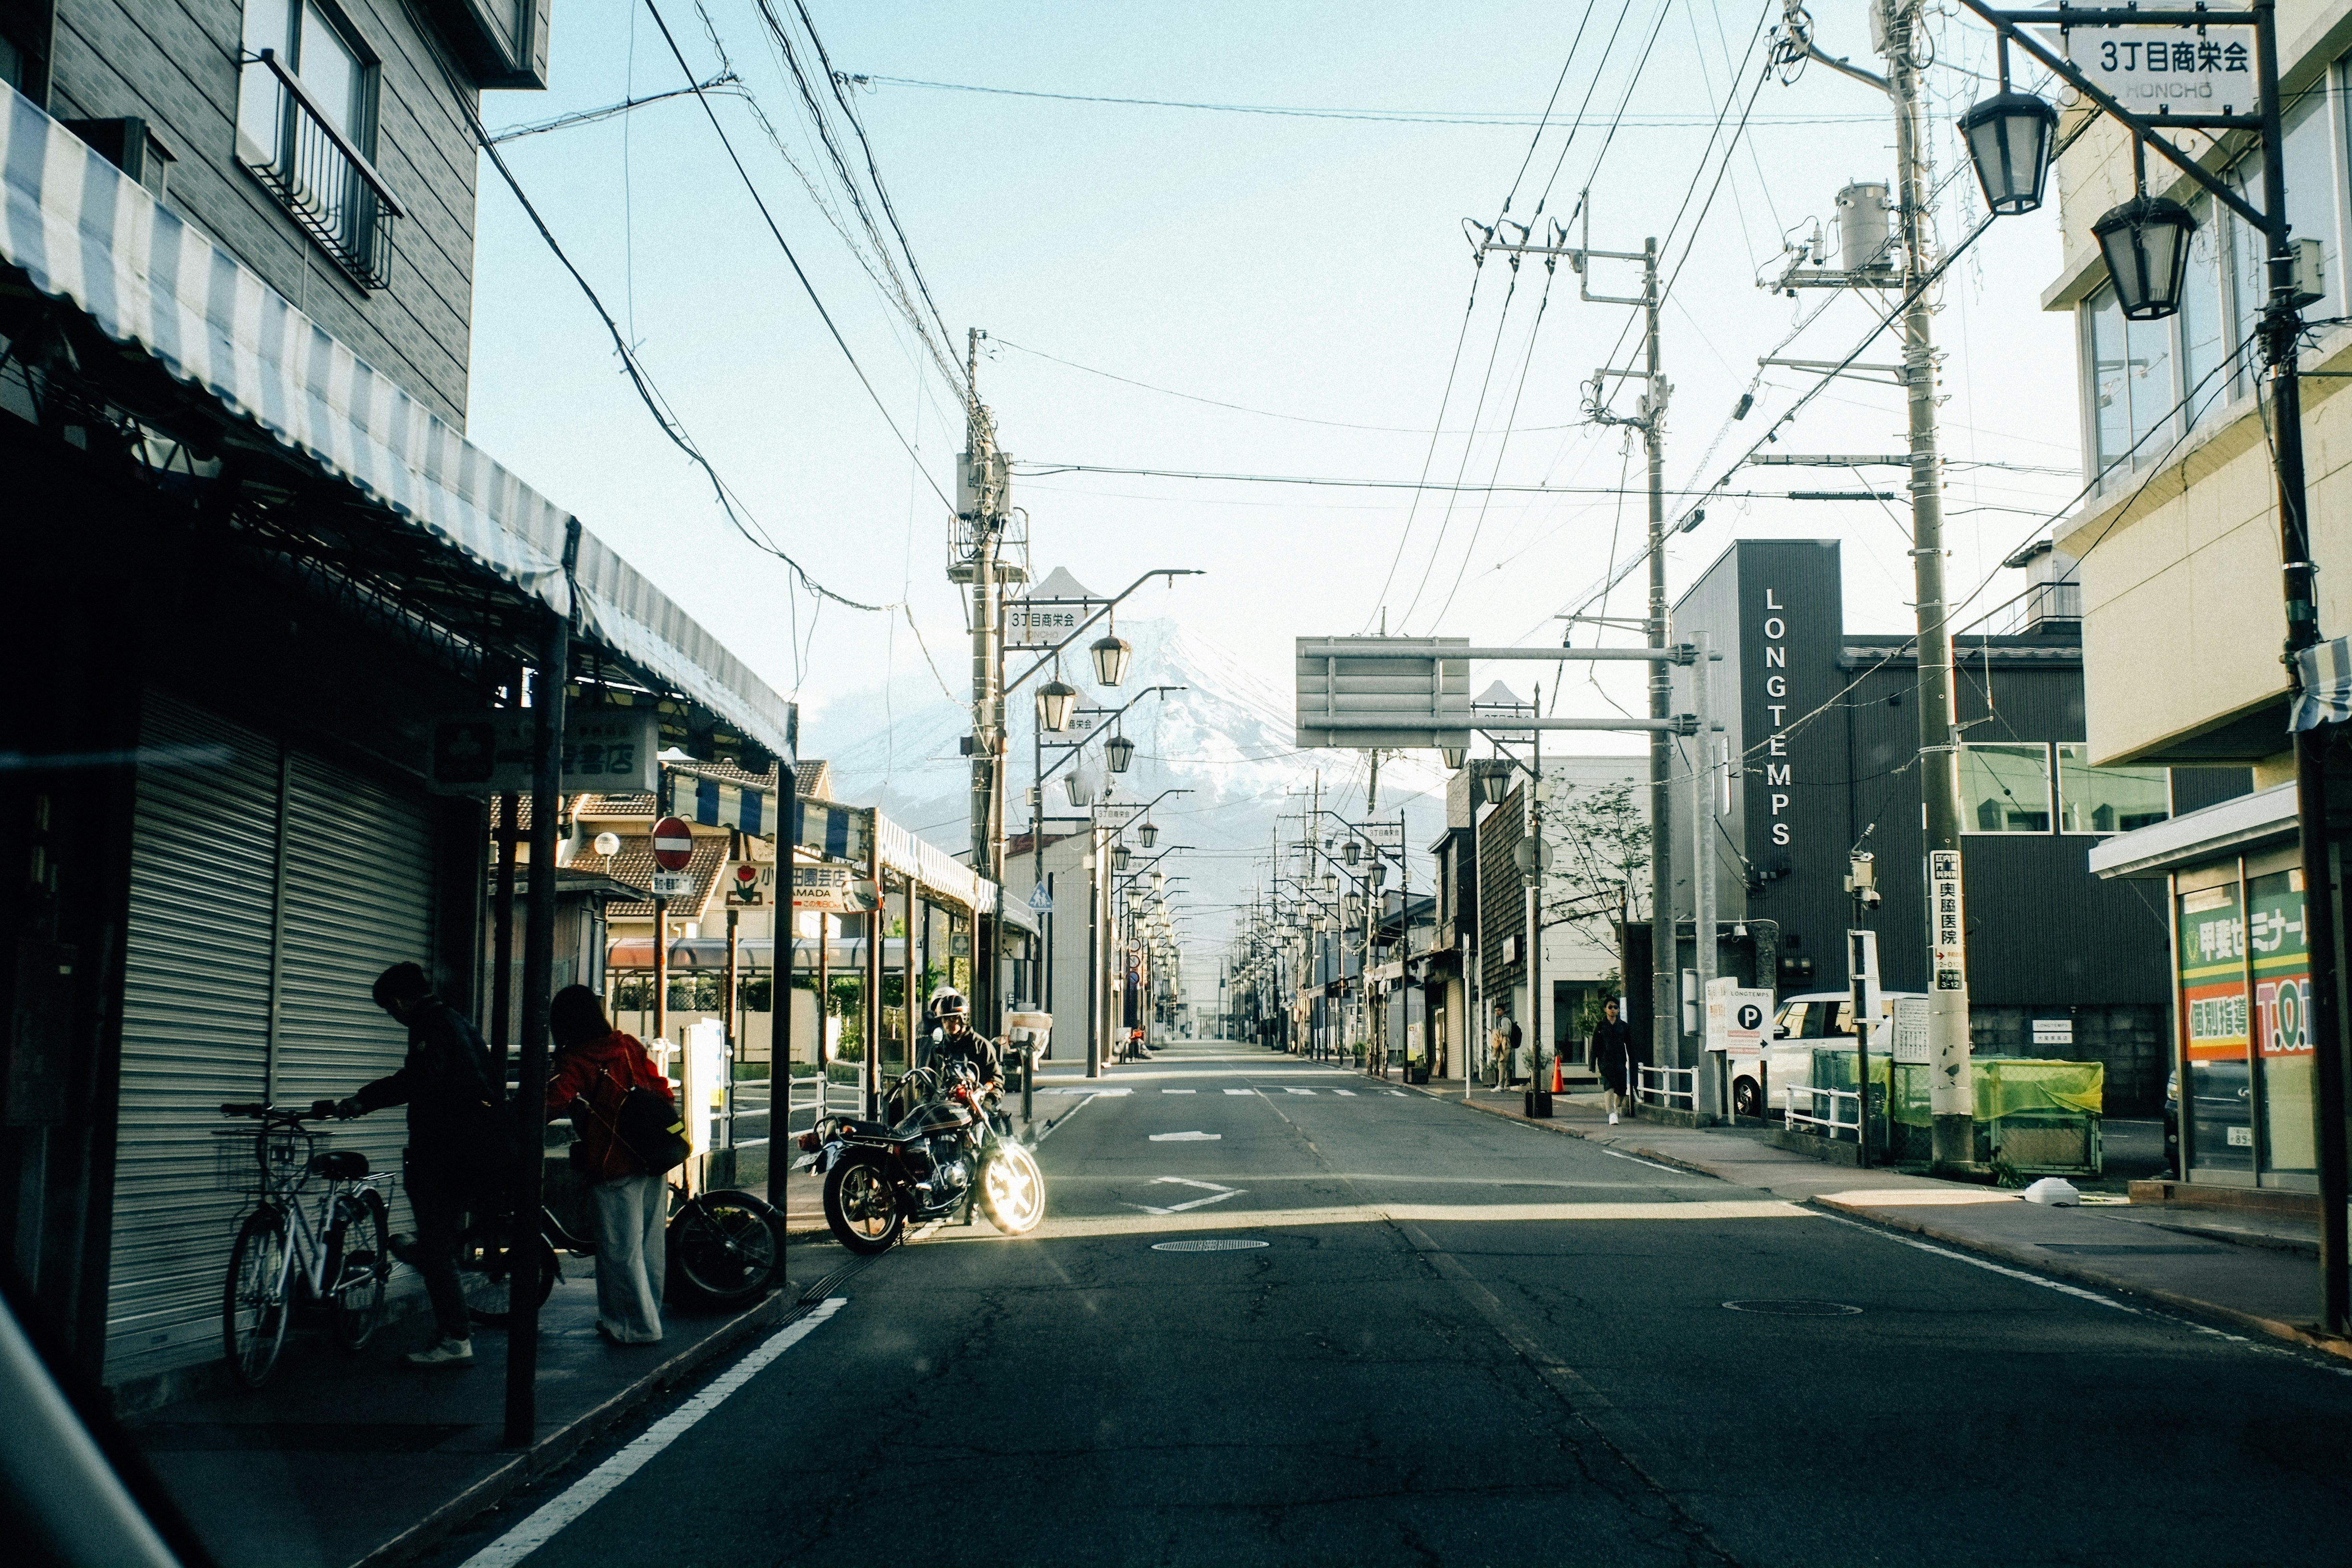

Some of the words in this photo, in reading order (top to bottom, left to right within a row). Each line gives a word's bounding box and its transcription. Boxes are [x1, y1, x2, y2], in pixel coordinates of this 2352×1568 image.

[2101, 41, 2248, 73] 3丁目商栄会
[1012, 613, 1074, 626] 3丁目商栄会
[1068, 719, 1091, 729] 商栄会
[1764, 588, 1790, 845] LONGTEMPS
[761, 867, 845, 887] 小田園芸店
[2190, 995, 2246, 1040] 個別指導
